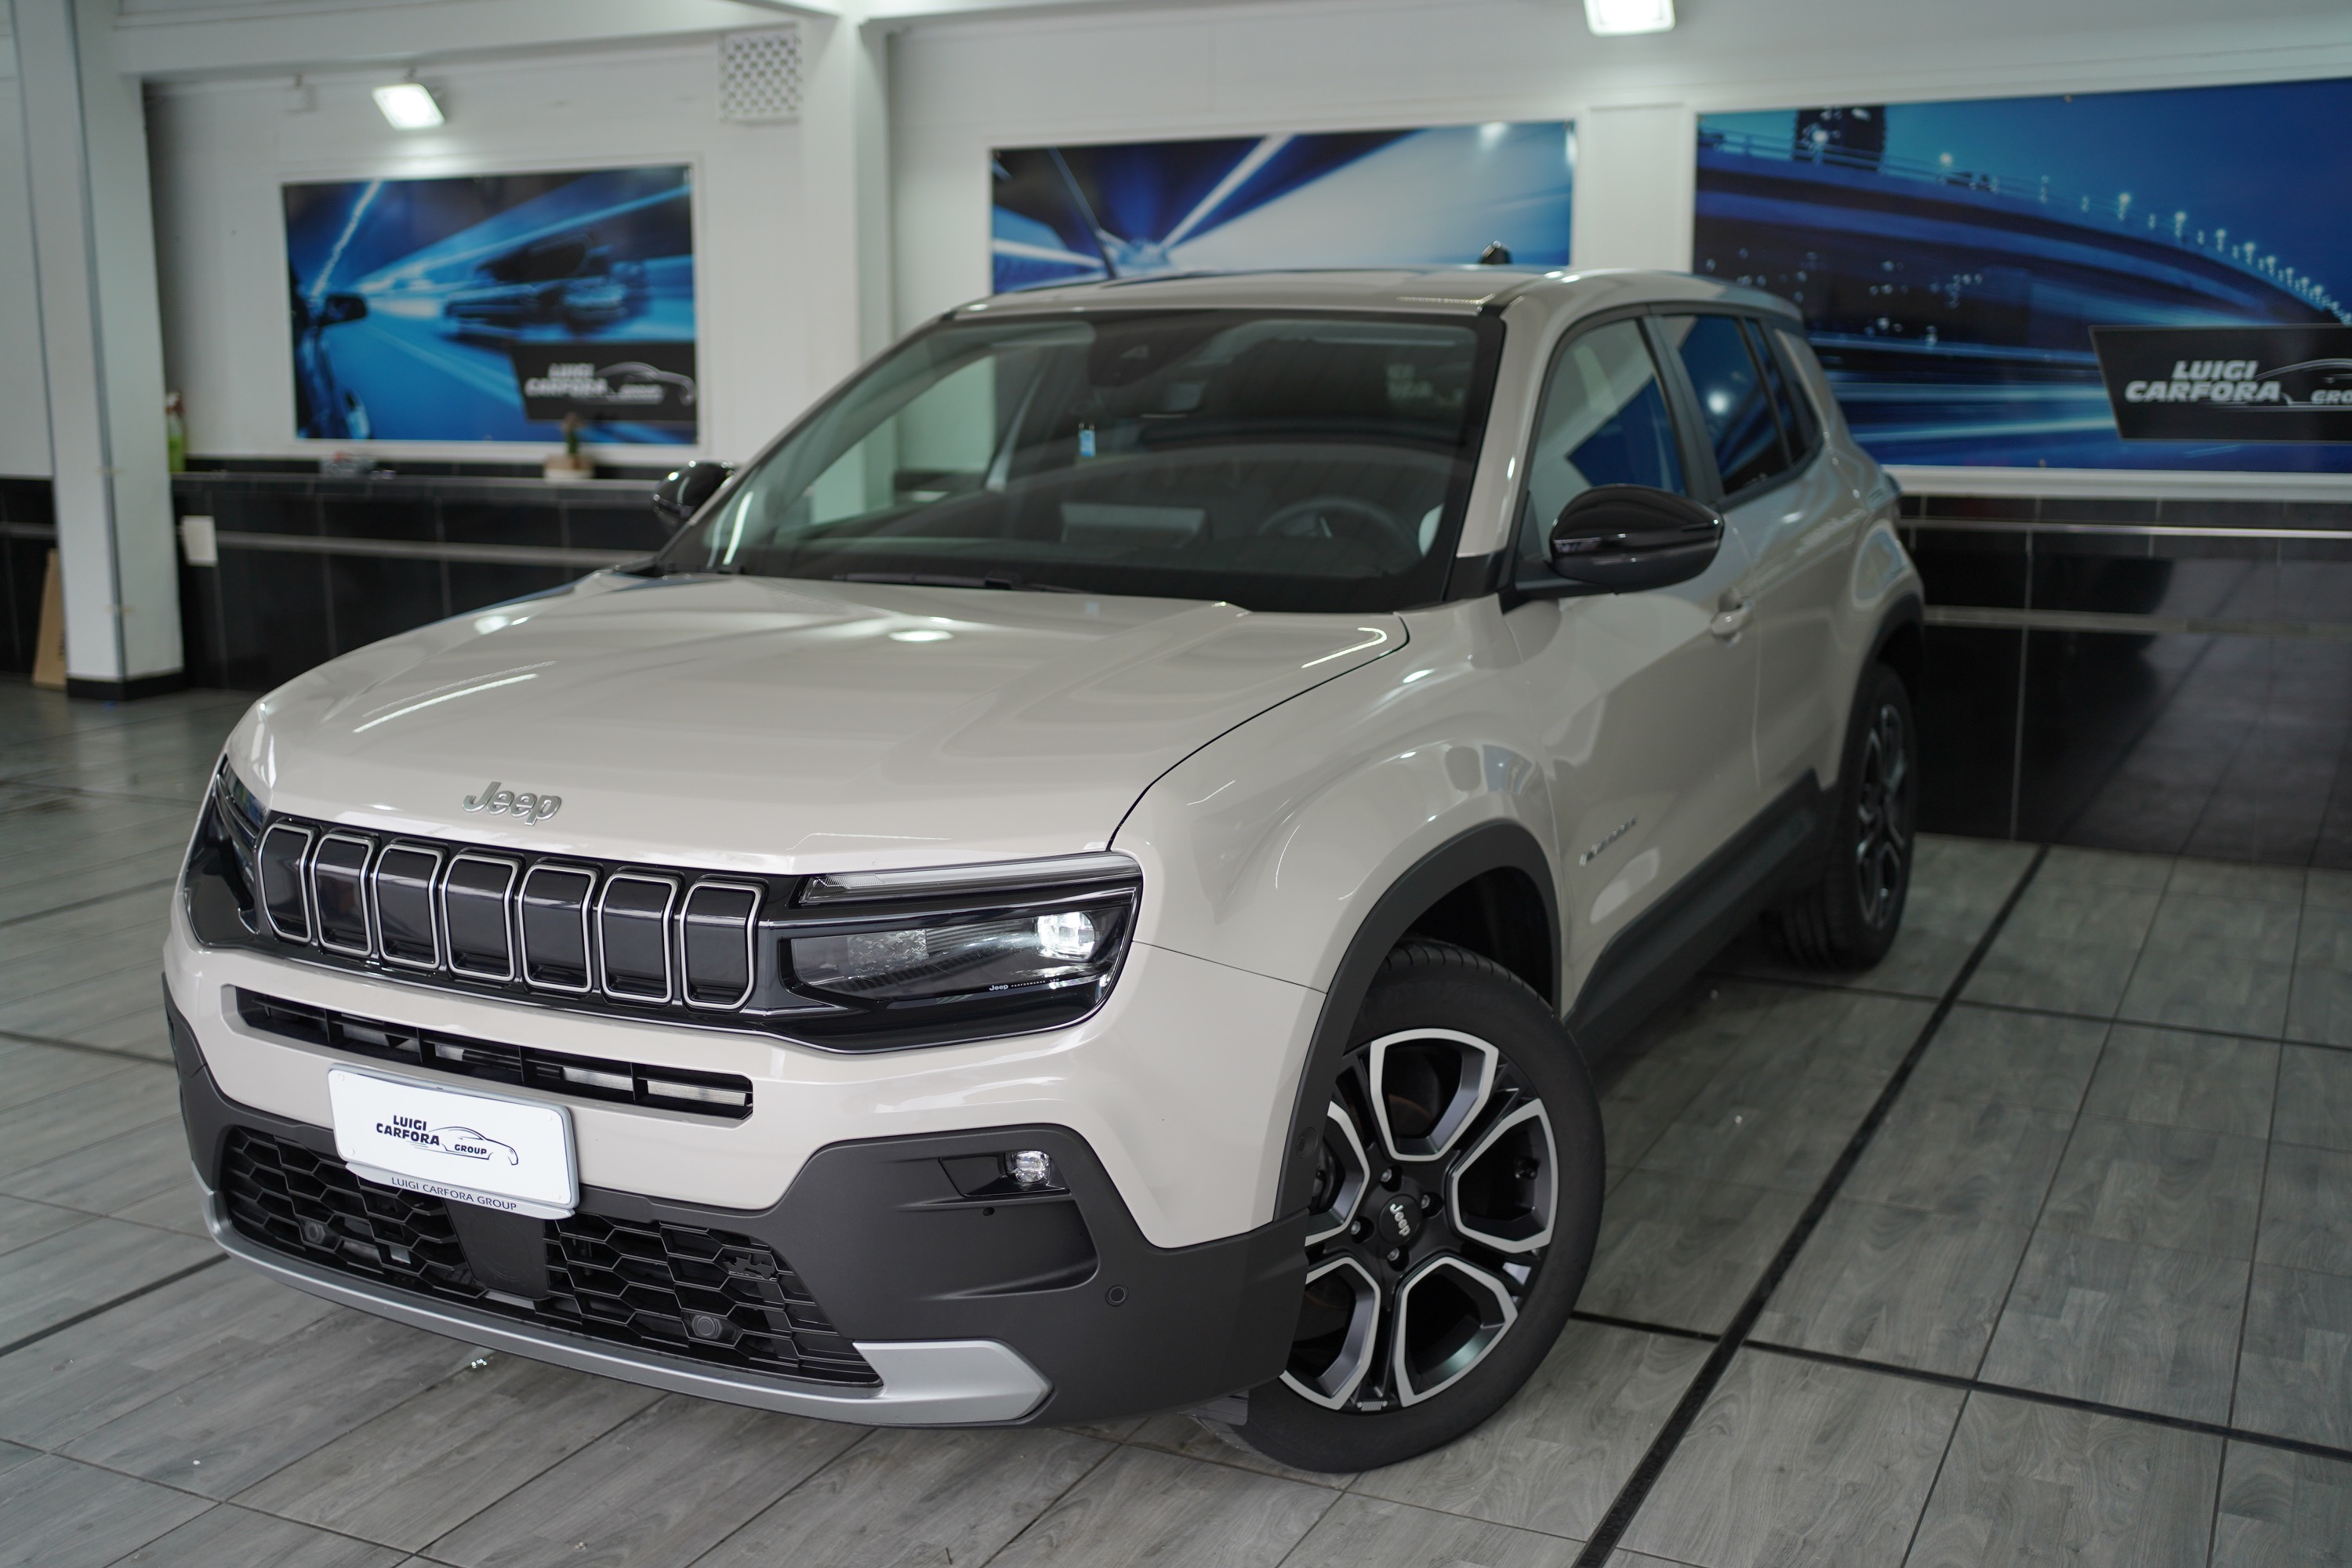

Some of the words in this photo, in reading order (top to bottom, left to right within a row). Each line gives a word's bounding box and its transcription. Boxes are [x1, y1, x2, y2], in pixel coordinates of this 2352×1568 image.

[2172, 360, 2259, 381] LUIGI
[2125, 379, 2281, 402] CARFORA
[462, 781, 562, 826] Jeep
[376, 1123, 440, 1146] CARFORA
[454, 1144, 488, 1156] GROUP
[393, 1115, 427, 1131] LUIGI
[391, 1177, 419, 1190] LUIGI
[423, 1184, 474, 1203] CARFORA
[477, 1196, 517, 1210] GROUP
[1389, 1203, 1410, 1236] Jeep
